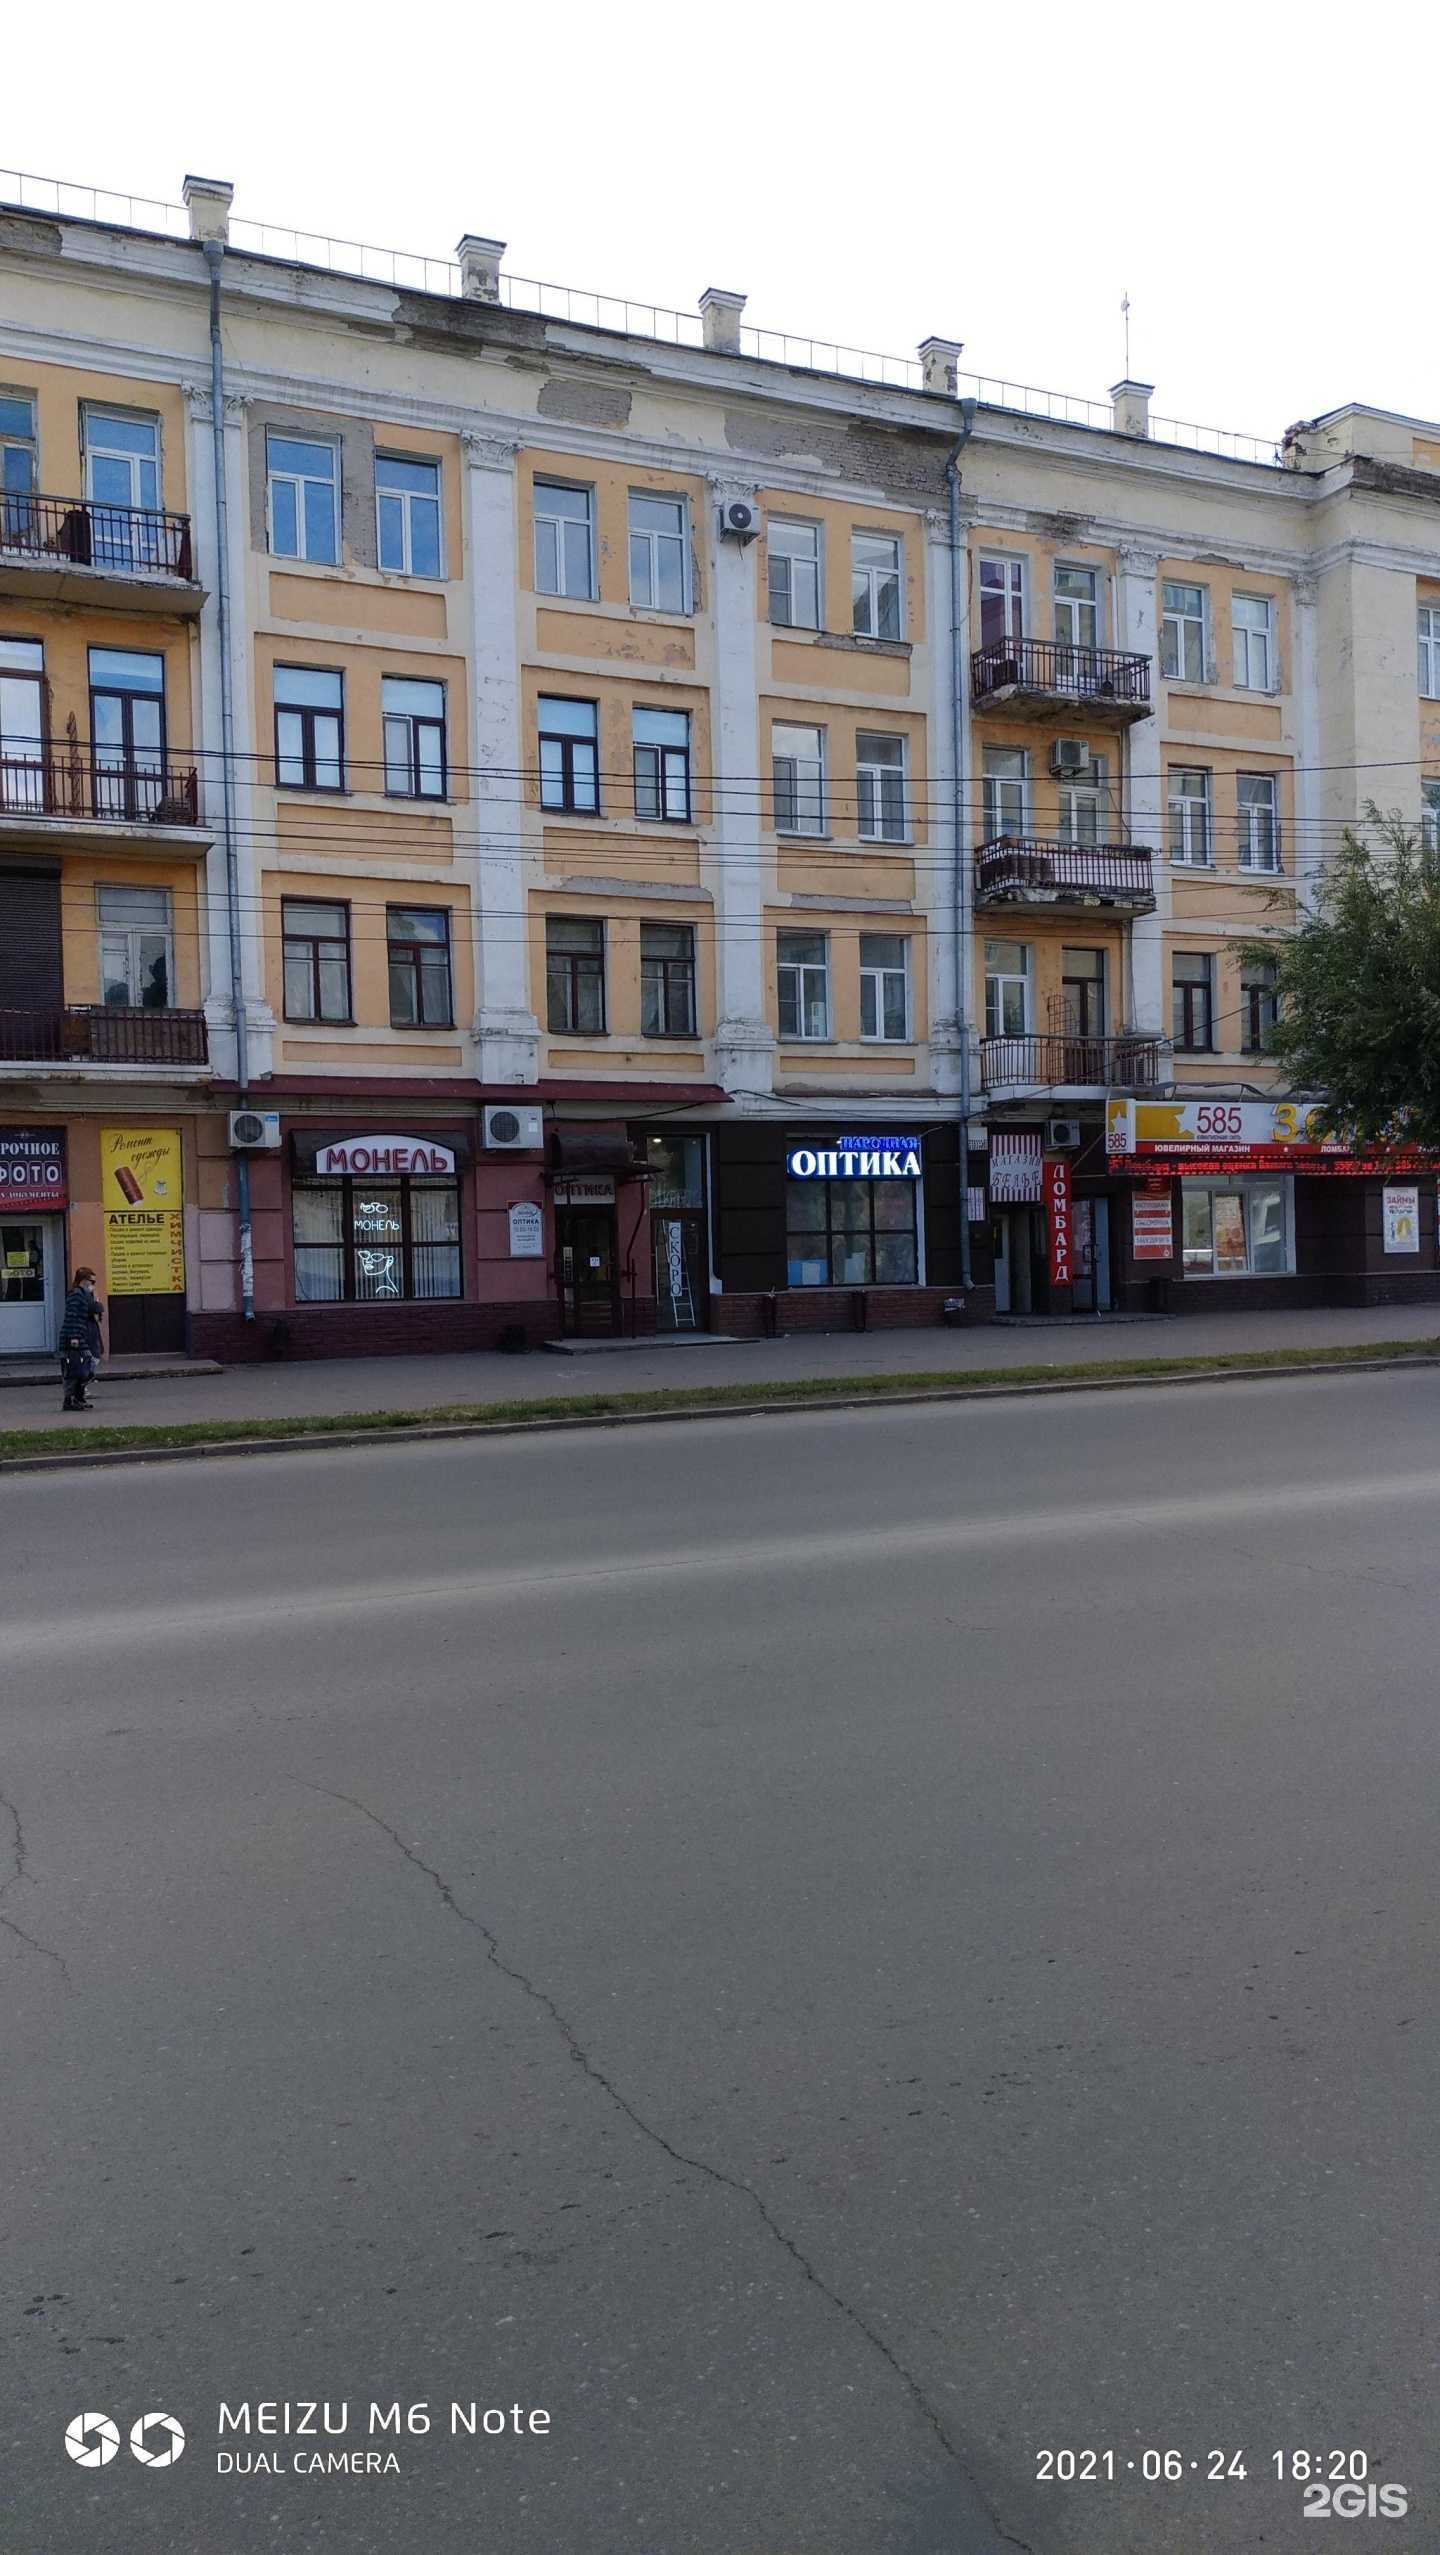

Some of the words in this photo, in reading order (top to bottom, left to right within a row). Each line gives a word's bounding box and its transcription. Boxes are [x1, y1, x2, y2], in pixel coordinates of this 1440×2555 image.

[1197, 1106, 1242, 1134] 585
[0, 1142, 60, 1155] РОЧНОЕ
[1108, 1133, 1127, 1149] 585
[1154, 1143, 1210, 1154] ЮВЕЛИРНЫЙ
[1211, 1144, 1251, 1154] МАГАЗИН
[326, 1148, 449, 1172] МОНЕЛЬ
[792, 1150, 921, 1176] ОПТИКА
[109, 1214, 165, 1225] АТЕЛЬЕ
[354, 1219, 400, 1231] МОНЕЛЬ
[1053, 1164, 1069, 1281] ЛОМБАРД
[169, 1213, 183, 1290] ХИМЧИСТКА
[669, 1226, 681, 1296] СКОРО
